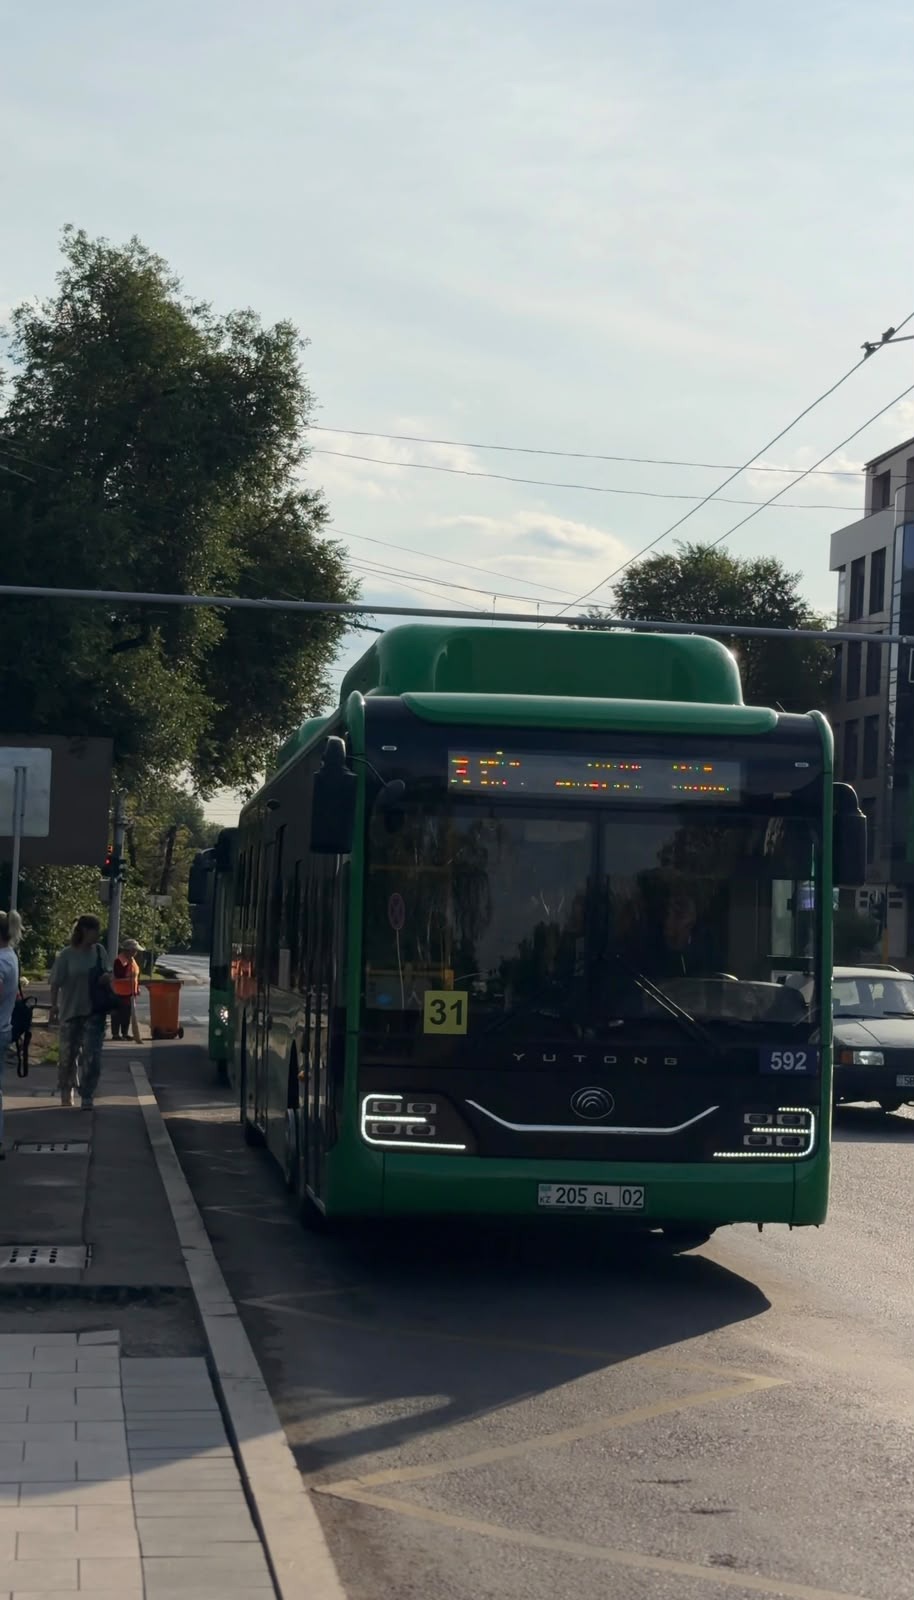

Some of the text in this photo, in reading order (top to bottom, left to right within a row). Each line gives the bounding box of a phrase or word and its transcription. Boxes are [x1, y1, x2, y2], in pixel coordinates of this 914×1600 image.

[429, 999, 463, 1026] 31
[512, 1053, 678, 1065] YUTONG
[770, 1051, 807, 1070] 592
[555, 1187, 588, 1205] 205
[593, 1191, 614, 1206] GL
[621, 1189, 643, 1207] 02
